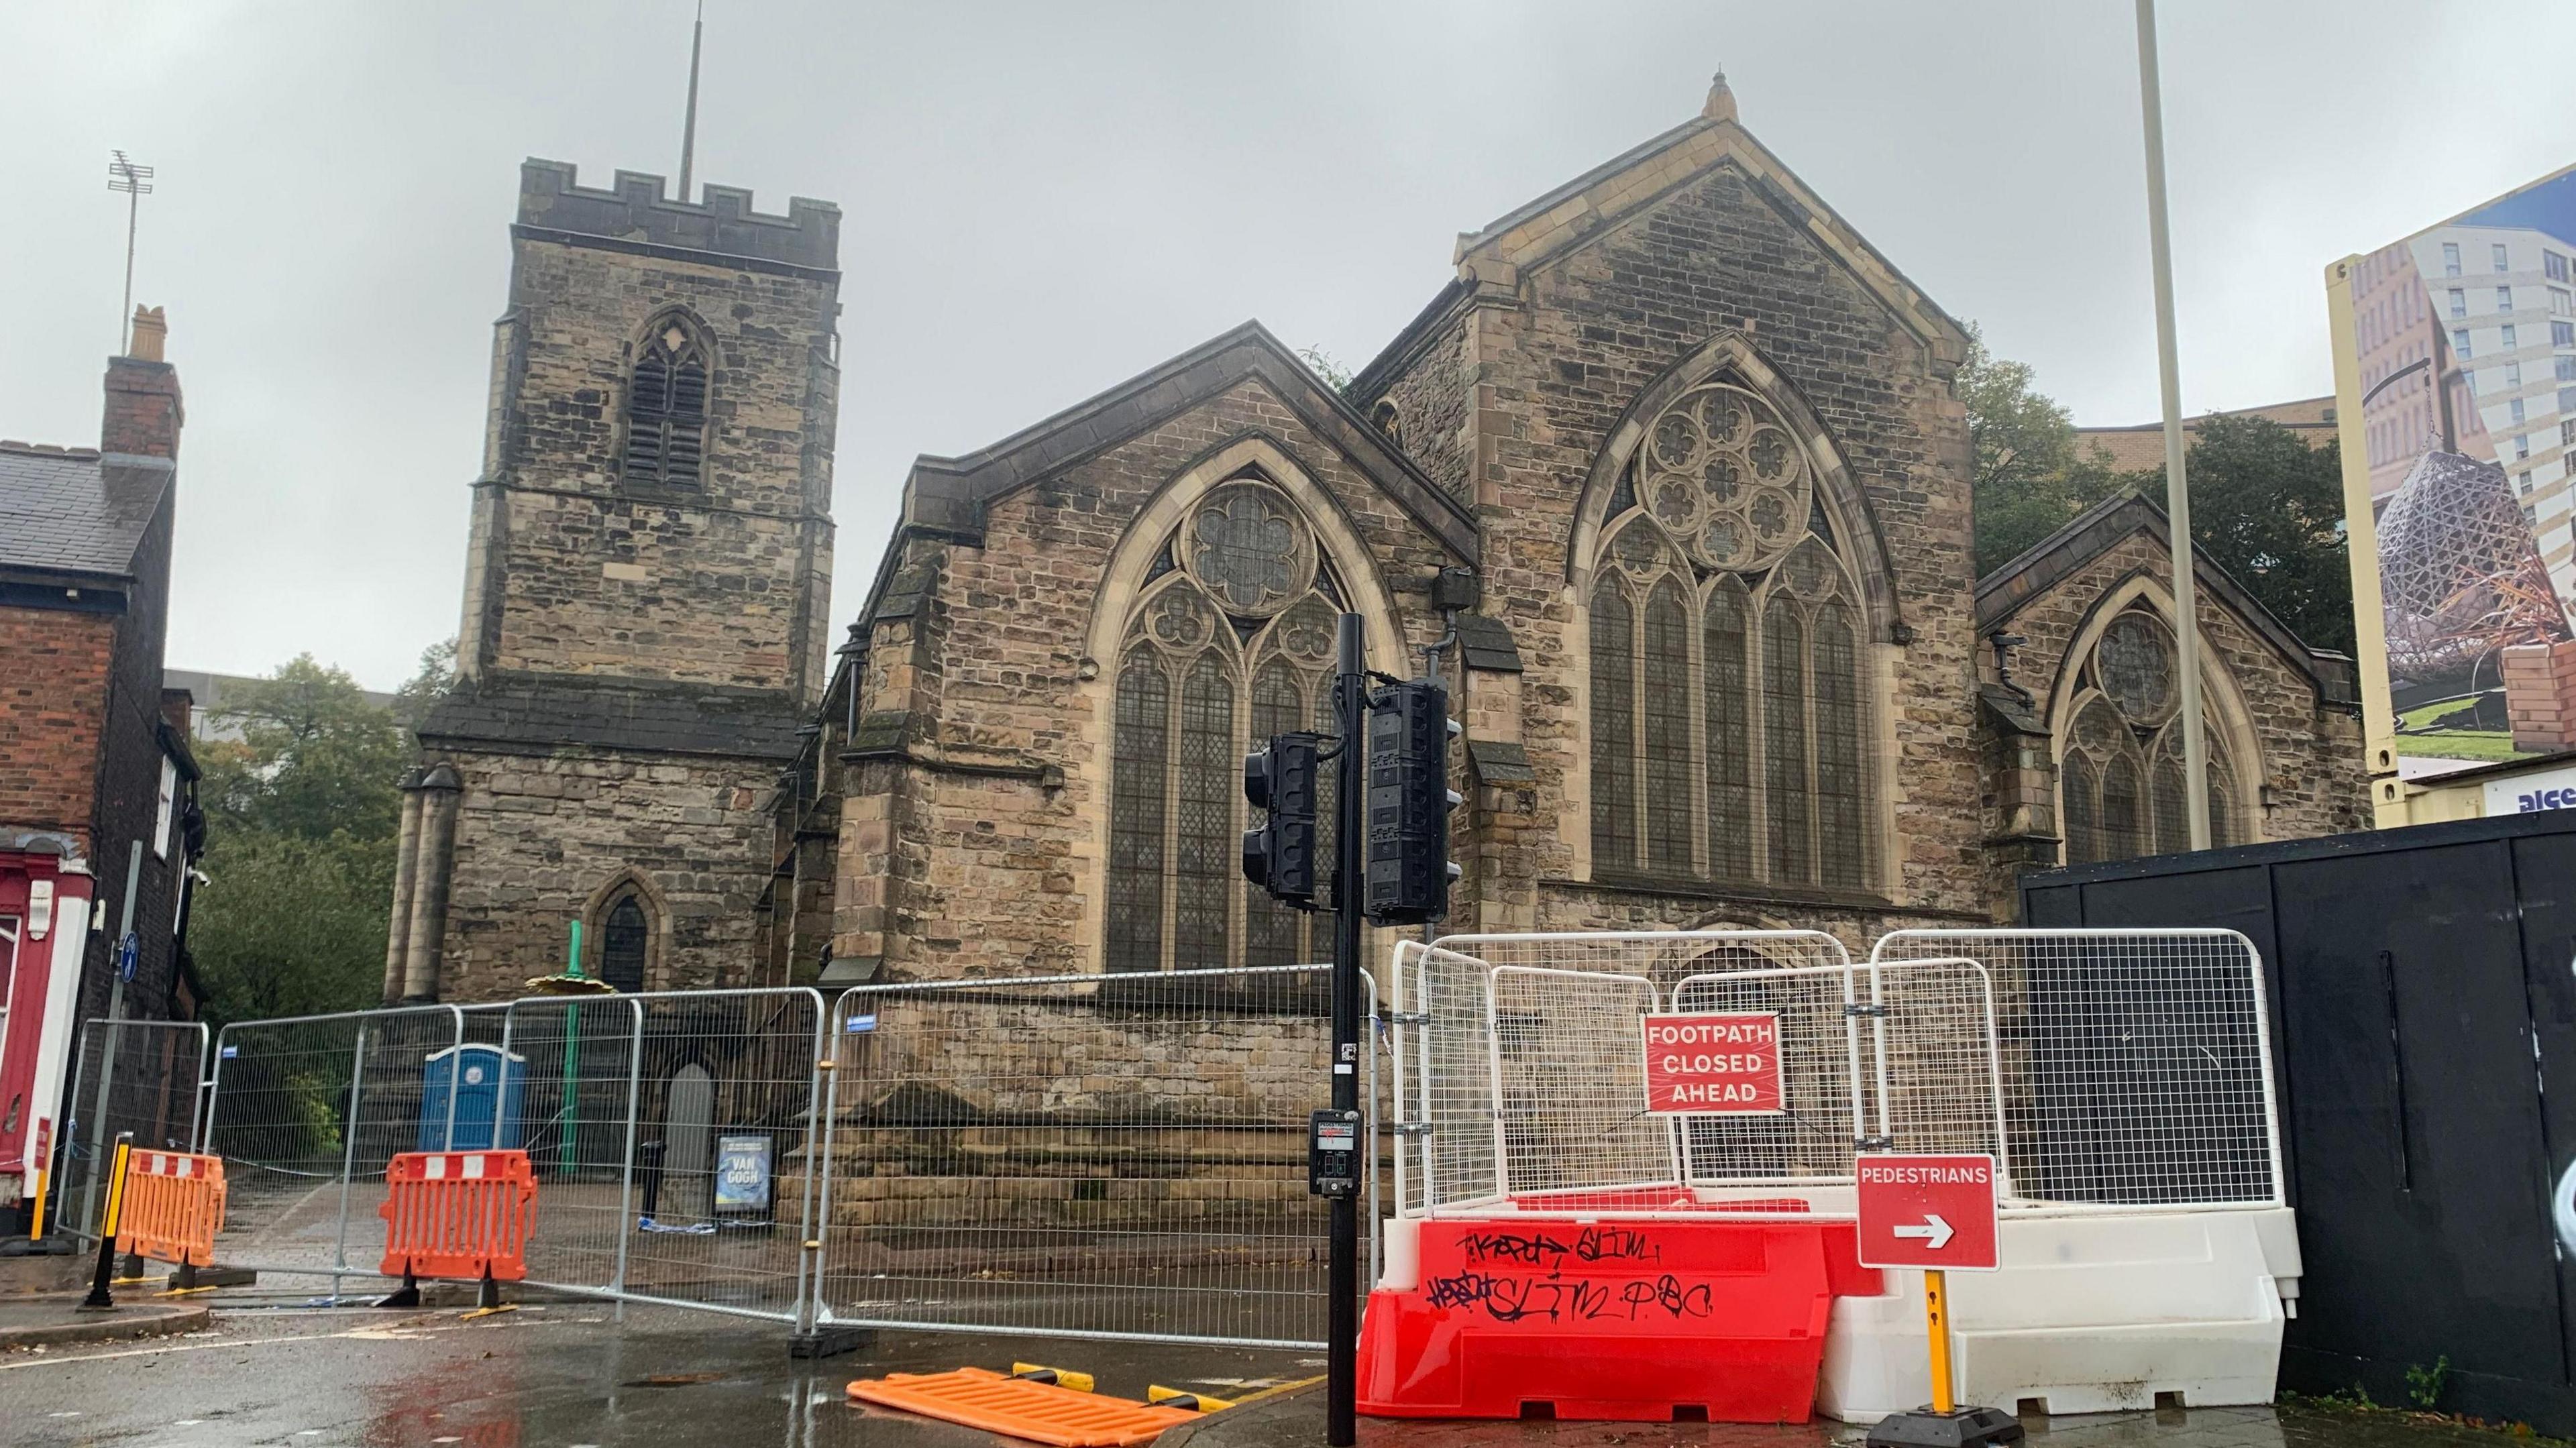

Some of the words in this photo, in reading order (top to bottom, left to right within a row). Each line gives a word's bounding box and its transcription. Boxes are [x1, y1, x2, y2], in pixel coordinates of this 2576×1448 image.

[1648, 1025, 1773, 1044] FOOTPATH
[1663, 1054, 1762, 1073] CLOSED
[1672, 1084, 1757, 1103] AHEAD
[733, 1158, 755, 1171] VAN
[727, 1170, 758, 1184] GOGH
[1861, 1167, 1988, 1184] PEDESTRIANS
